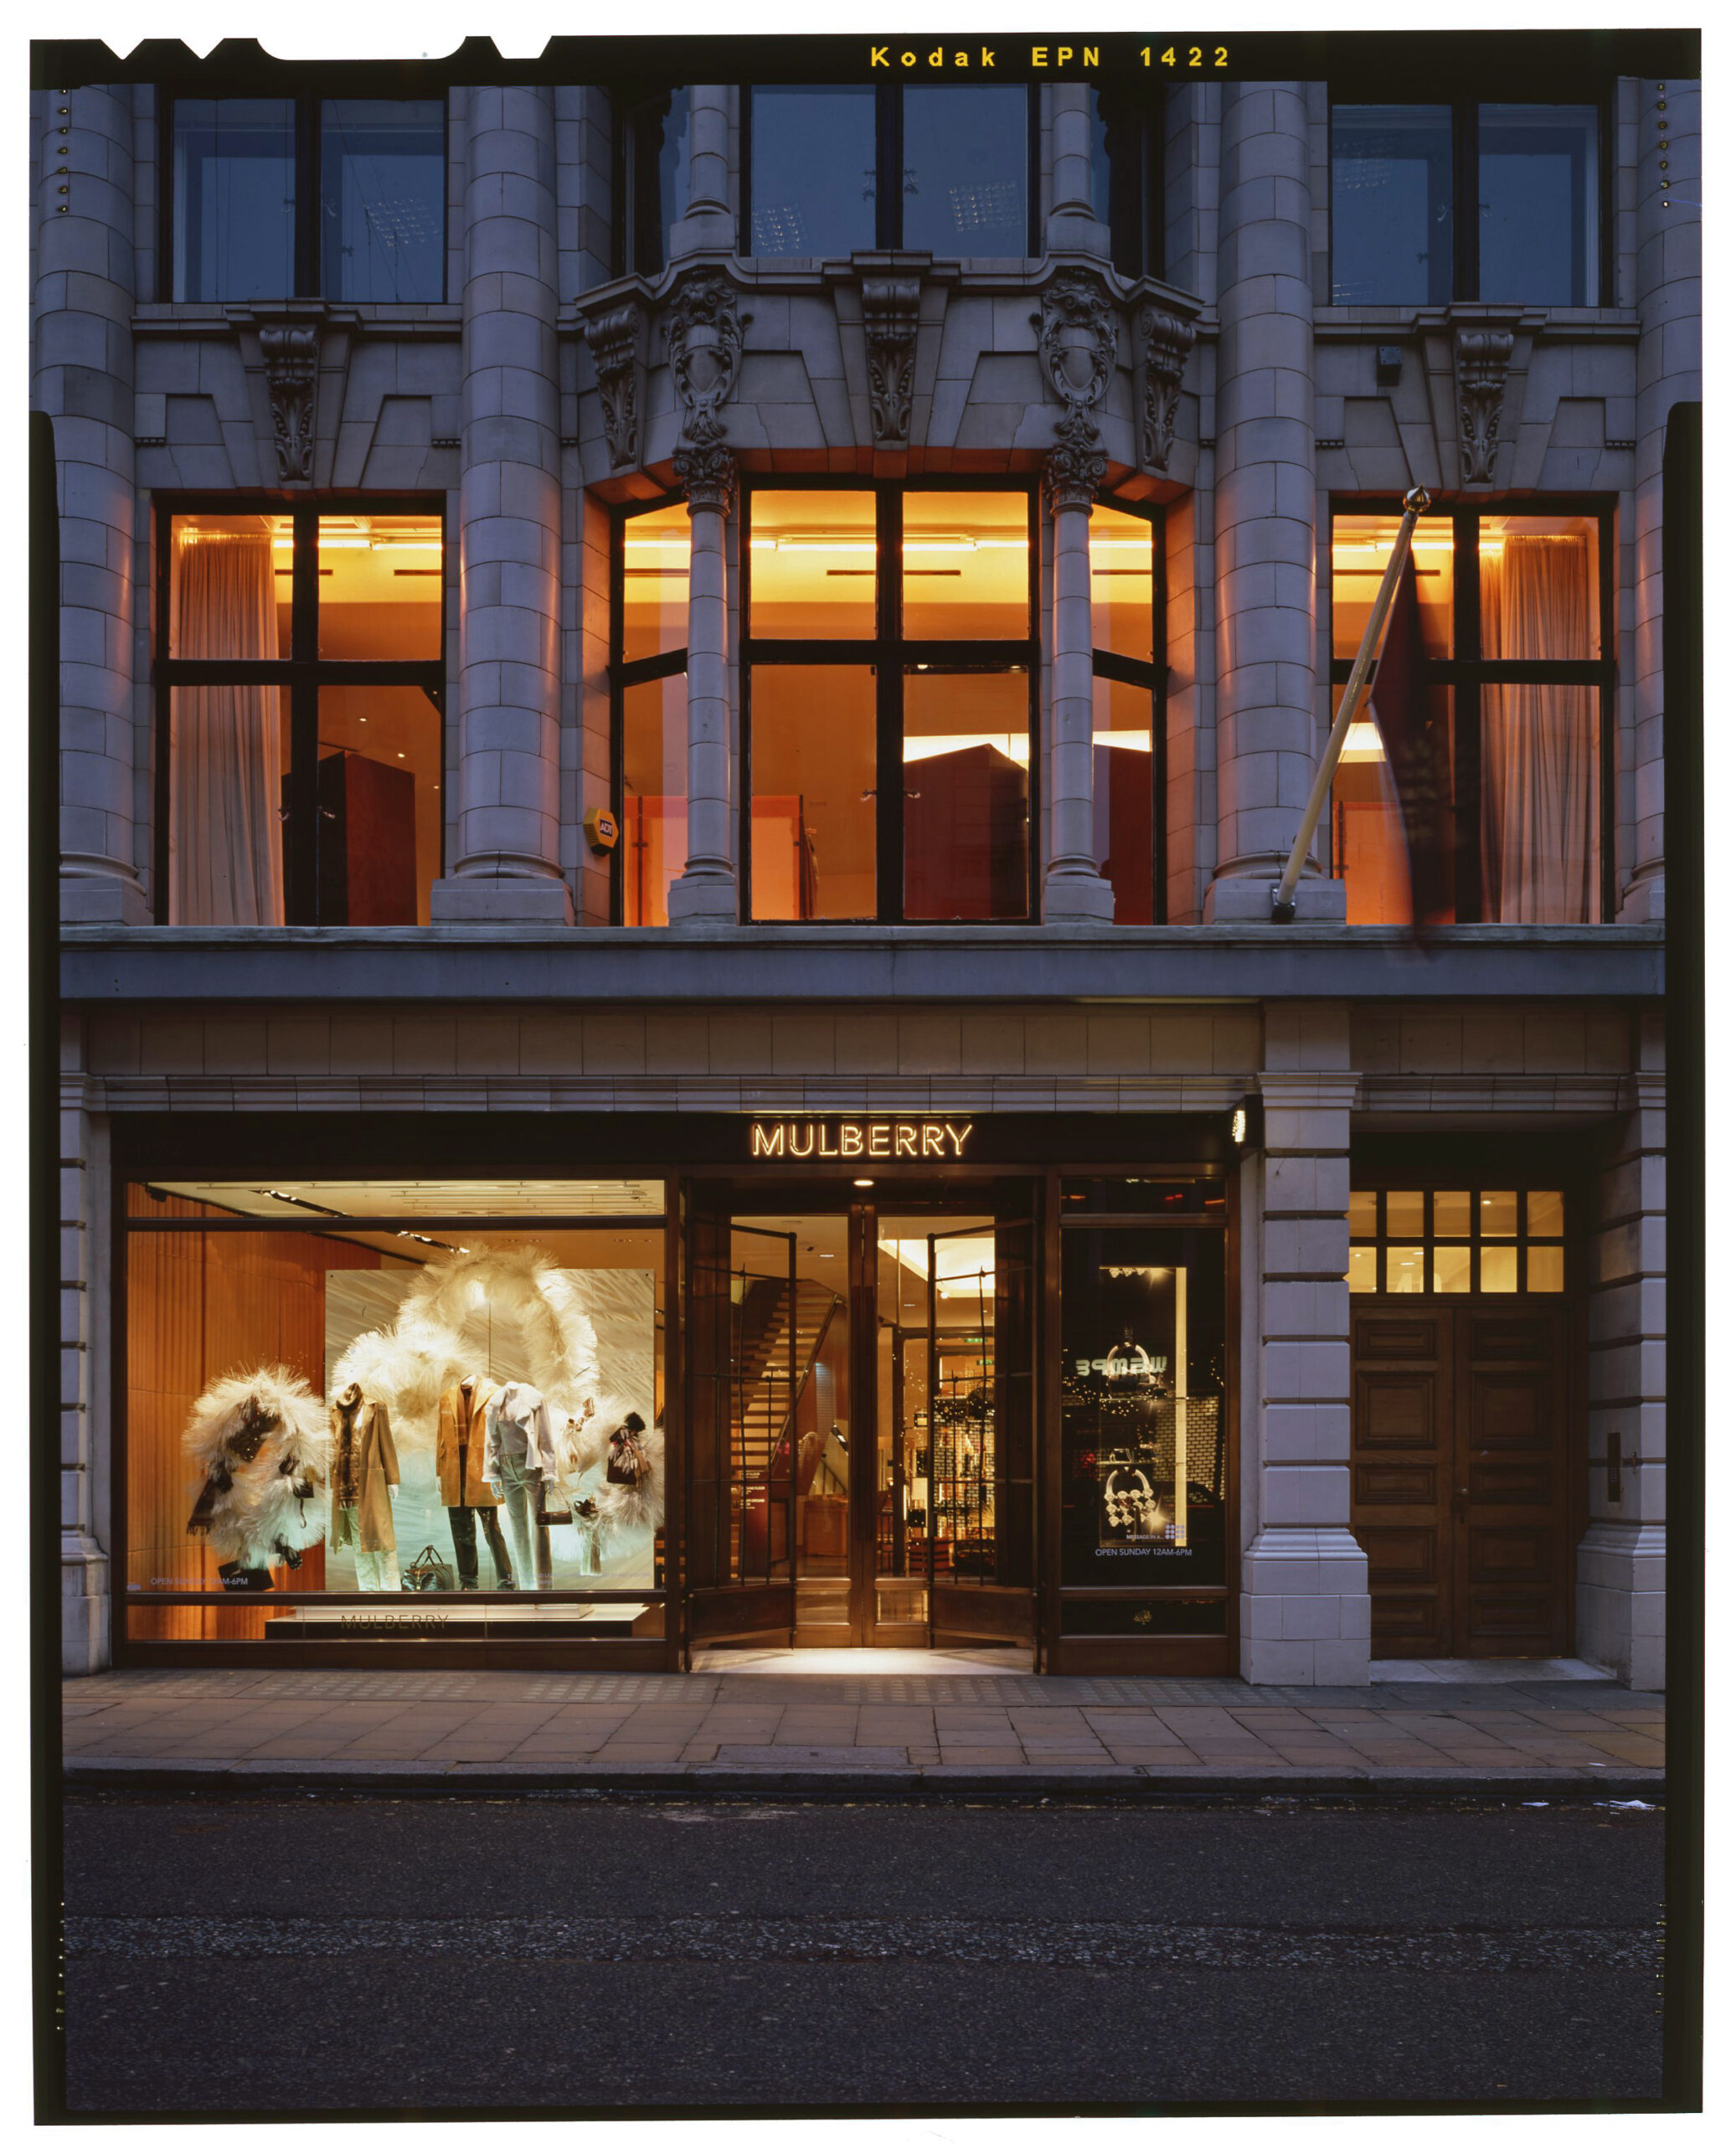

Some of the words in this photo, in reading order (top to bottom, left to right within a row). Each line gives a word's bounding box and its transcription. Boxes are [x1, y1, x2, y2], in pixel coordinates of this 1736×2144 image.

[870, 46, 996, 67] Kodak
[1031, 46, 1100, 67] EPN
[1140, 46, 1229, 67] 1422
[752, 1123, 973, 1156] MULBERRY
[1095, 1549, 1118, 1557] OPEN
[1119, 1548, 1151, 1556] SUNDAY
[1153, 1548, 1193, 1556] 12AM-6PM
[150, 1576, 173, 1585] OPEN
[341, 1615, 449, 1629] MULBERRY
